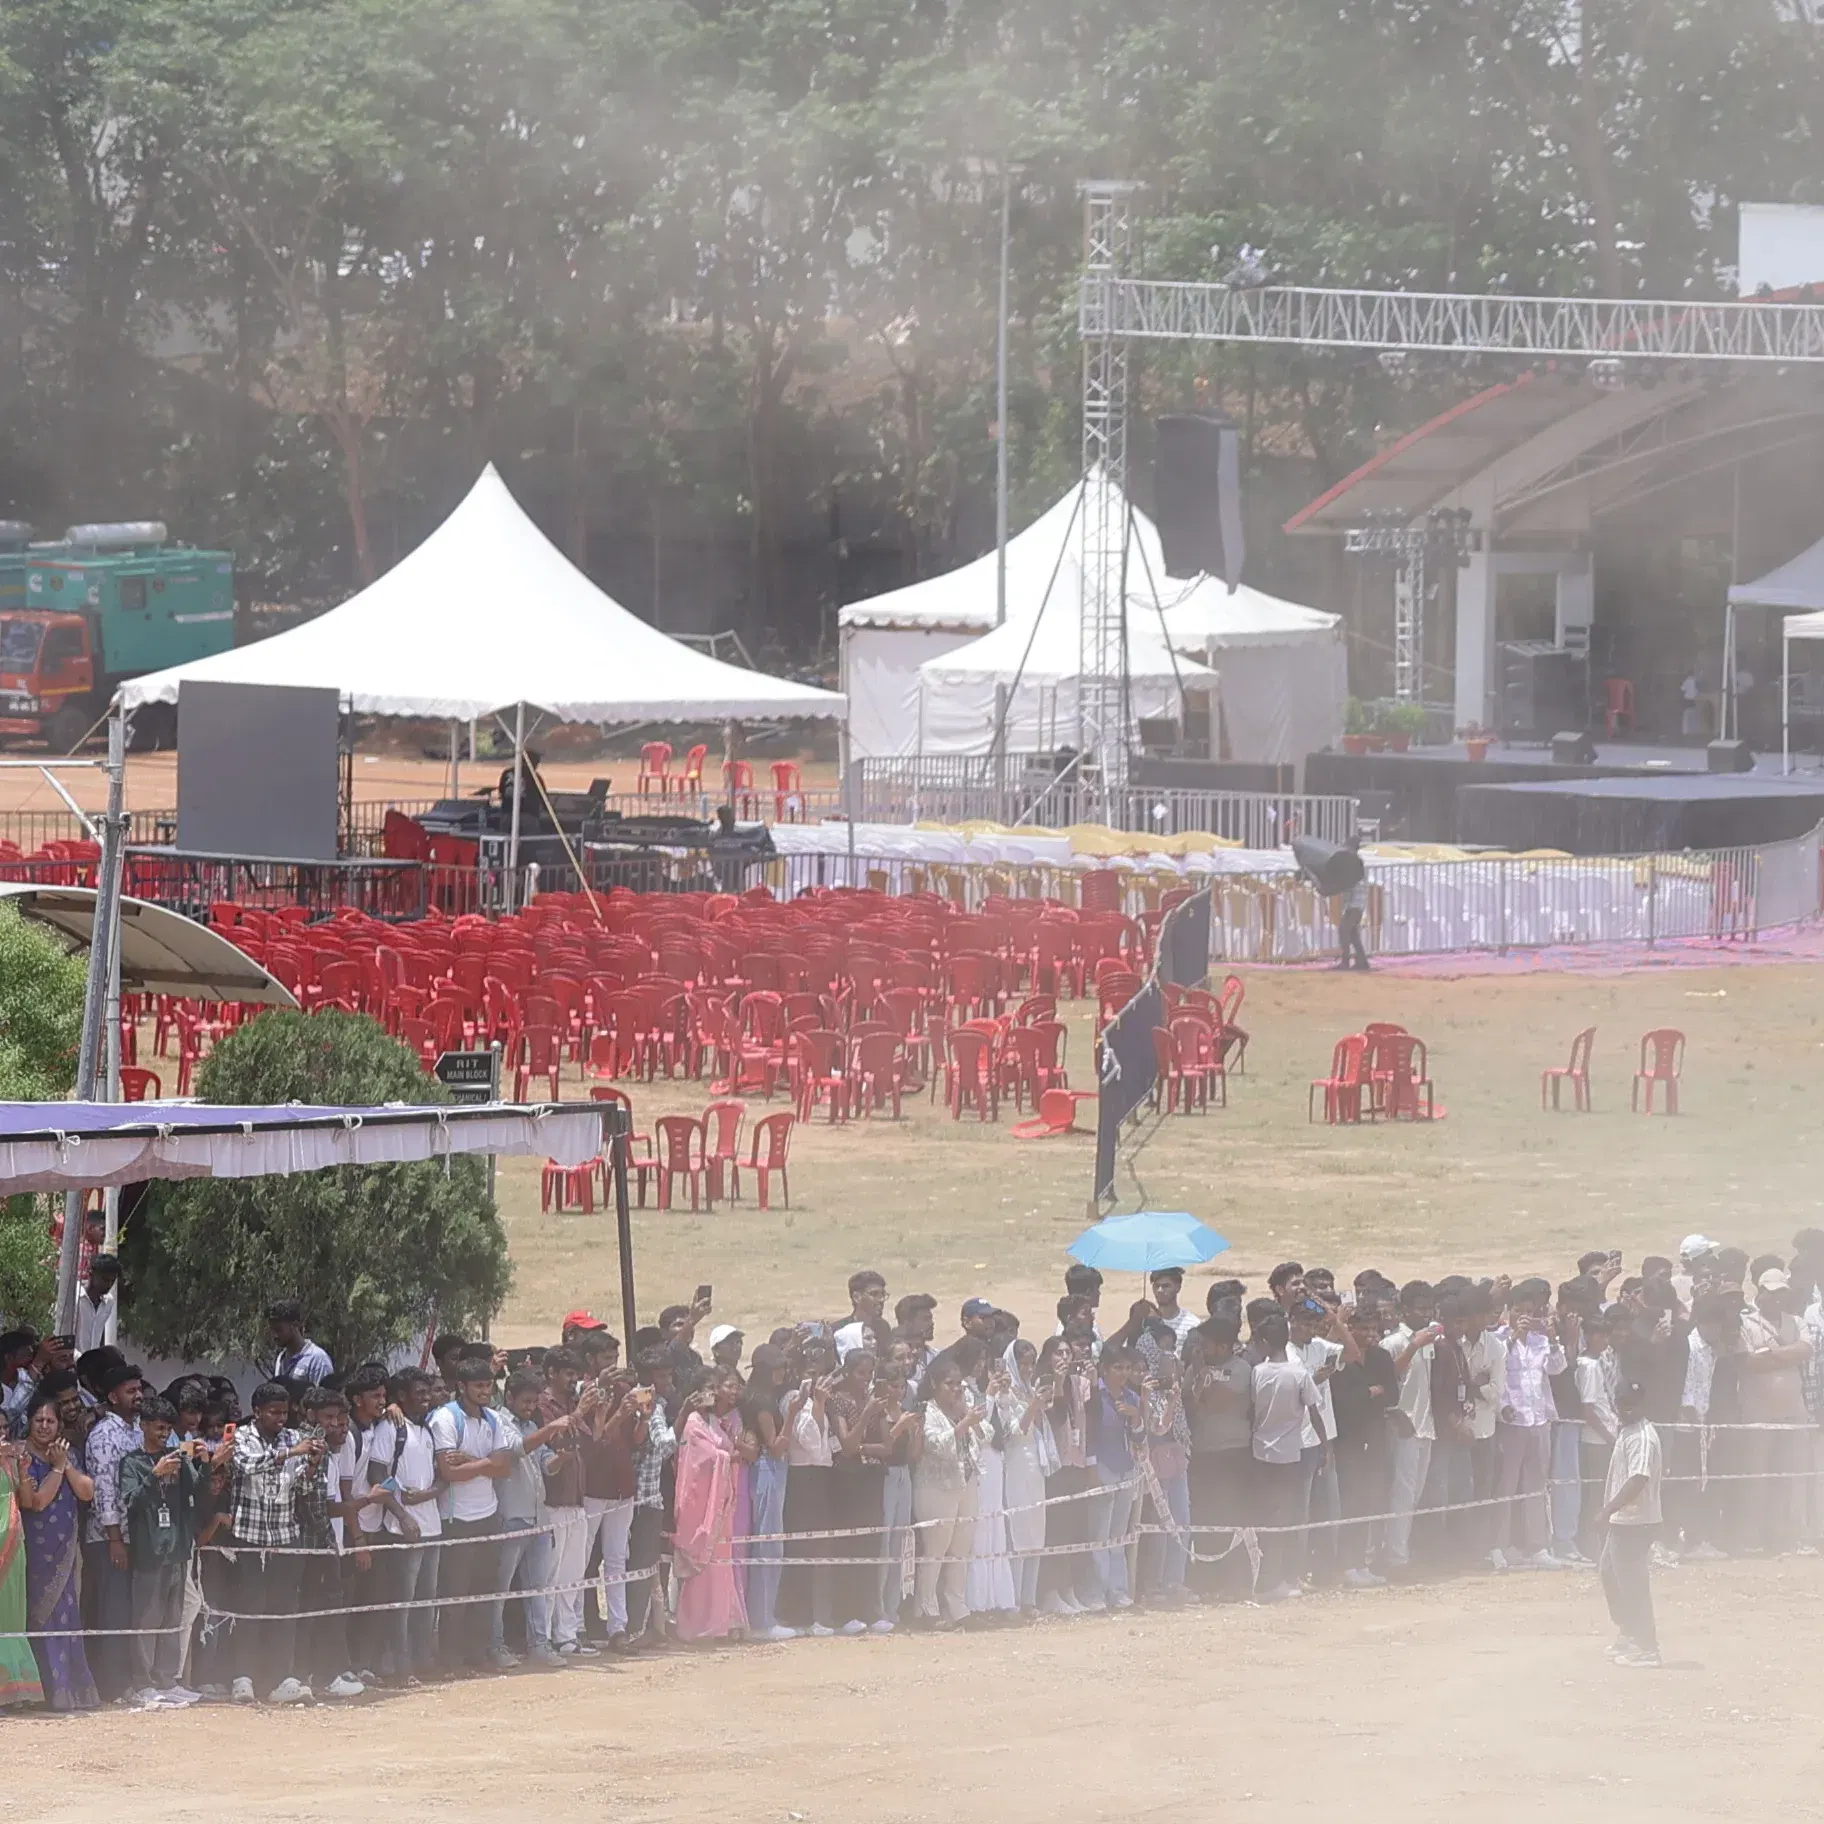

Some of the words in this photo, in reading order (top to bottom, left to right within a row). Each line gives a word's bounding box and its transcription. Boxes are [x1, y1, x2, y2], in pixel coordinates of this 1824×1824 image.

[456, 1059, 479, 1069] RIT
[446, 1070, 464, 1080] MAIN
[465, 1069, 488, 1080] BLOCK
